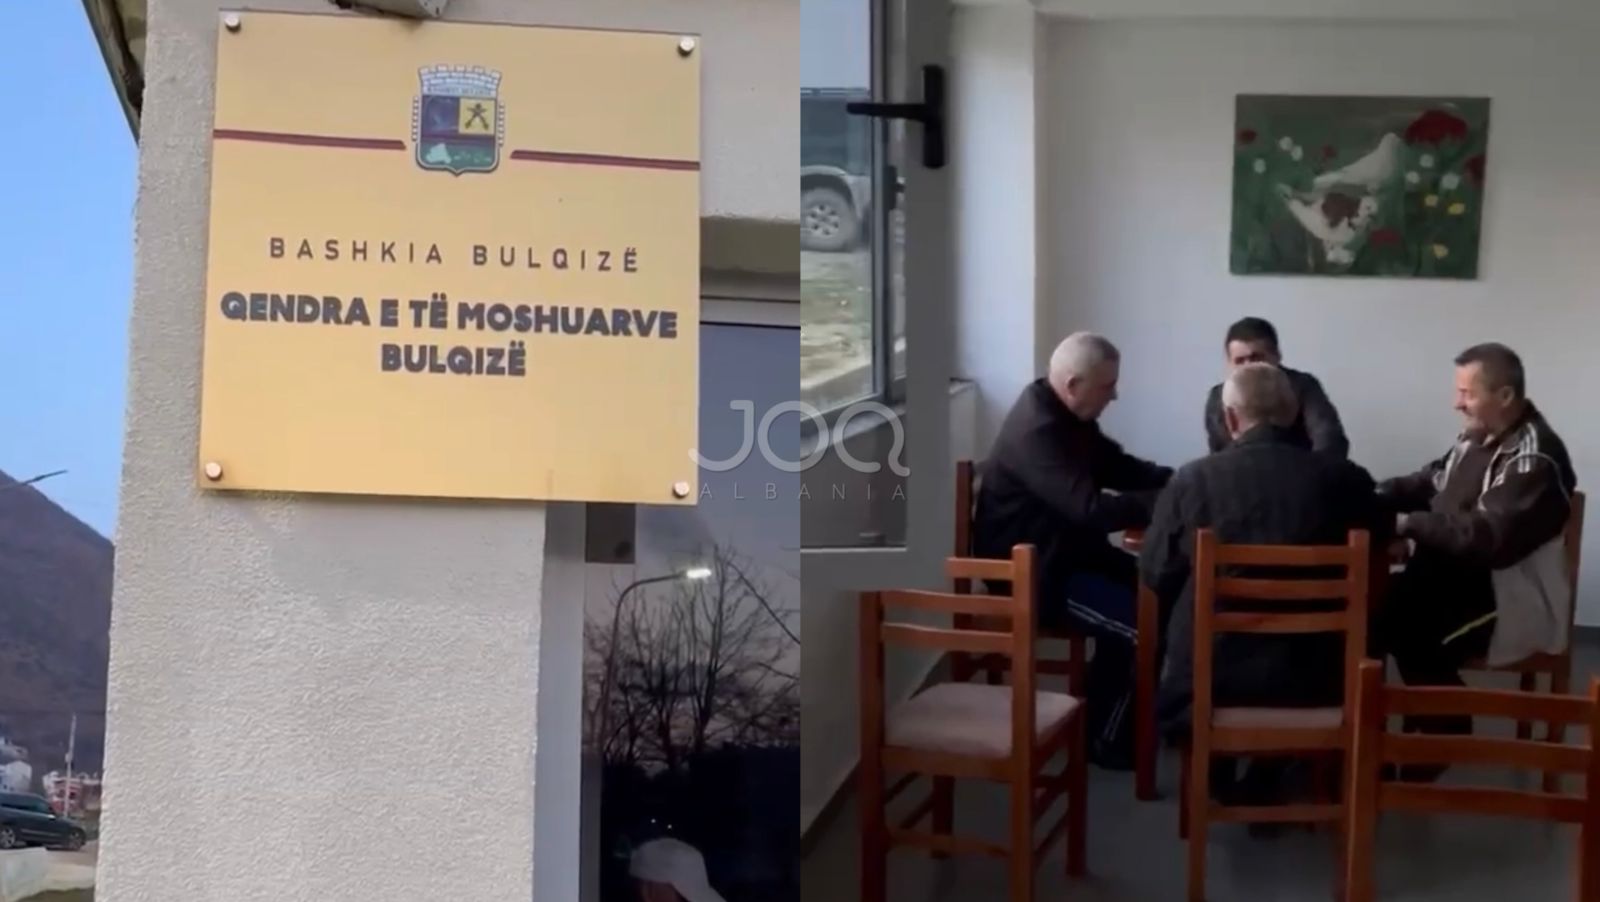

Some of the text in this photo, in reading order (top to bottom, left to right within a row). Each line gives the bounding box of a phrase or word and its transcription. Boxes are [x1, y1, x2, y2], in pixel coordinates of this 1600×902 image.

[270, 237, 638, 273] BASHKIA BULQIZË
[220, 291, 678, 338] QENDRA E TË MOSHUARVE
[381, 340, 526, 376] BULQIZË
